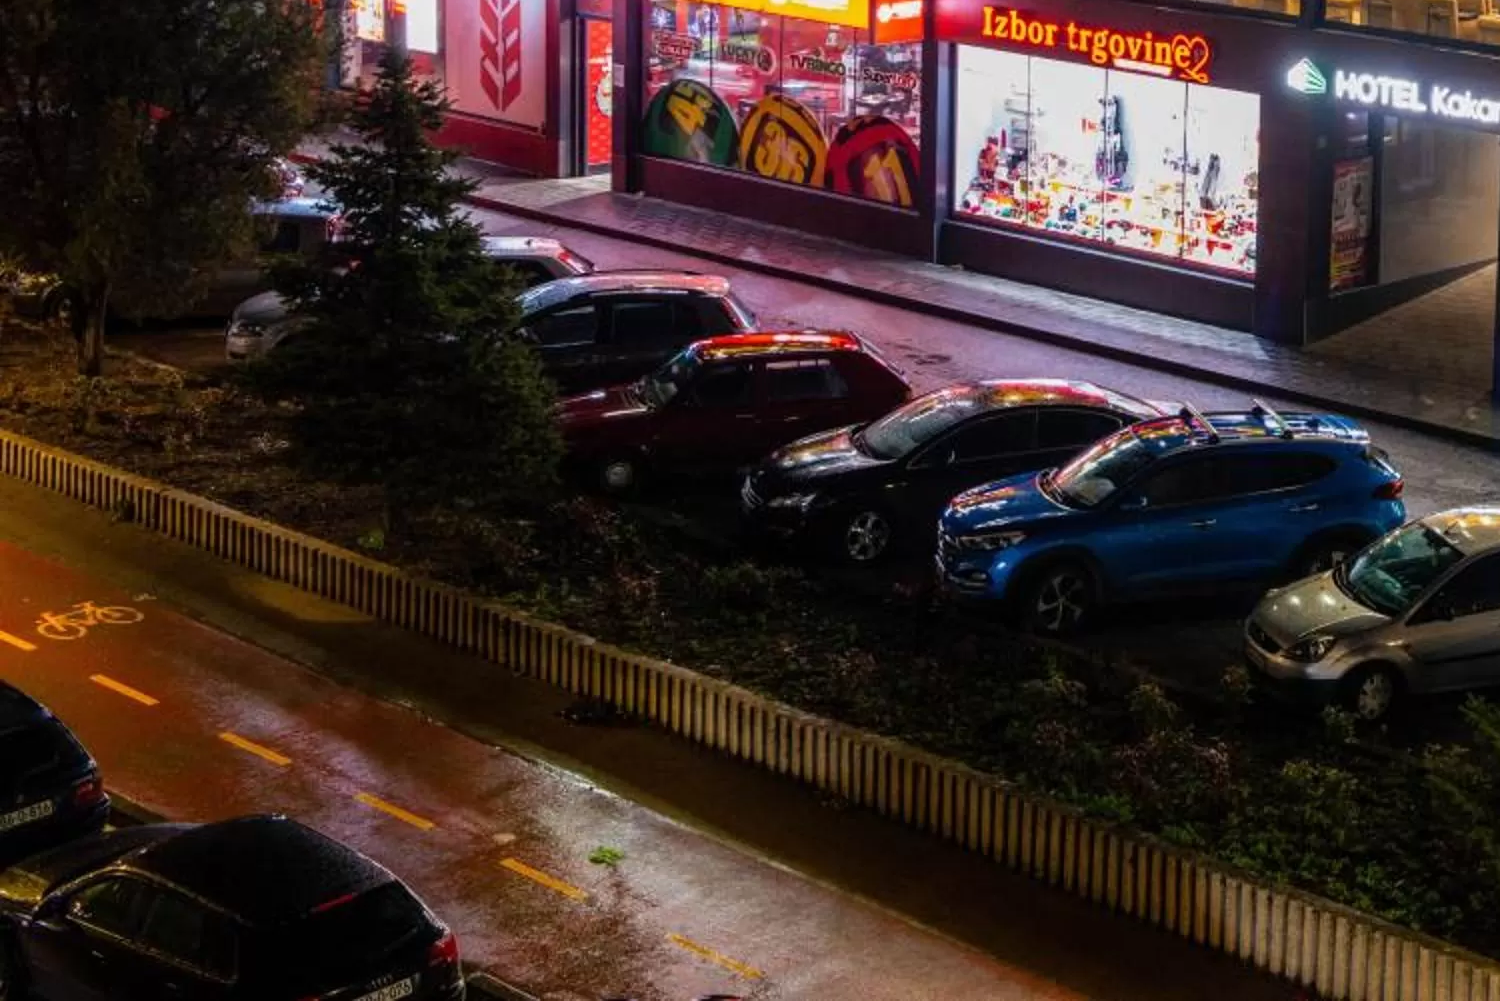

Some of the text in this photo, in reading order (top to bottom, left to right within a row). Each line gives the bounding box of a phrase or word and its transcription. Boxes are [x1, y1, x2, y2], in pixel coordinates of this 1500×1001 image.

[982, 6, 1057, 46] Izbor
[1067, 21, 1191, 68] trgovine
[1335, 70, 1426, 112] HOTEL
